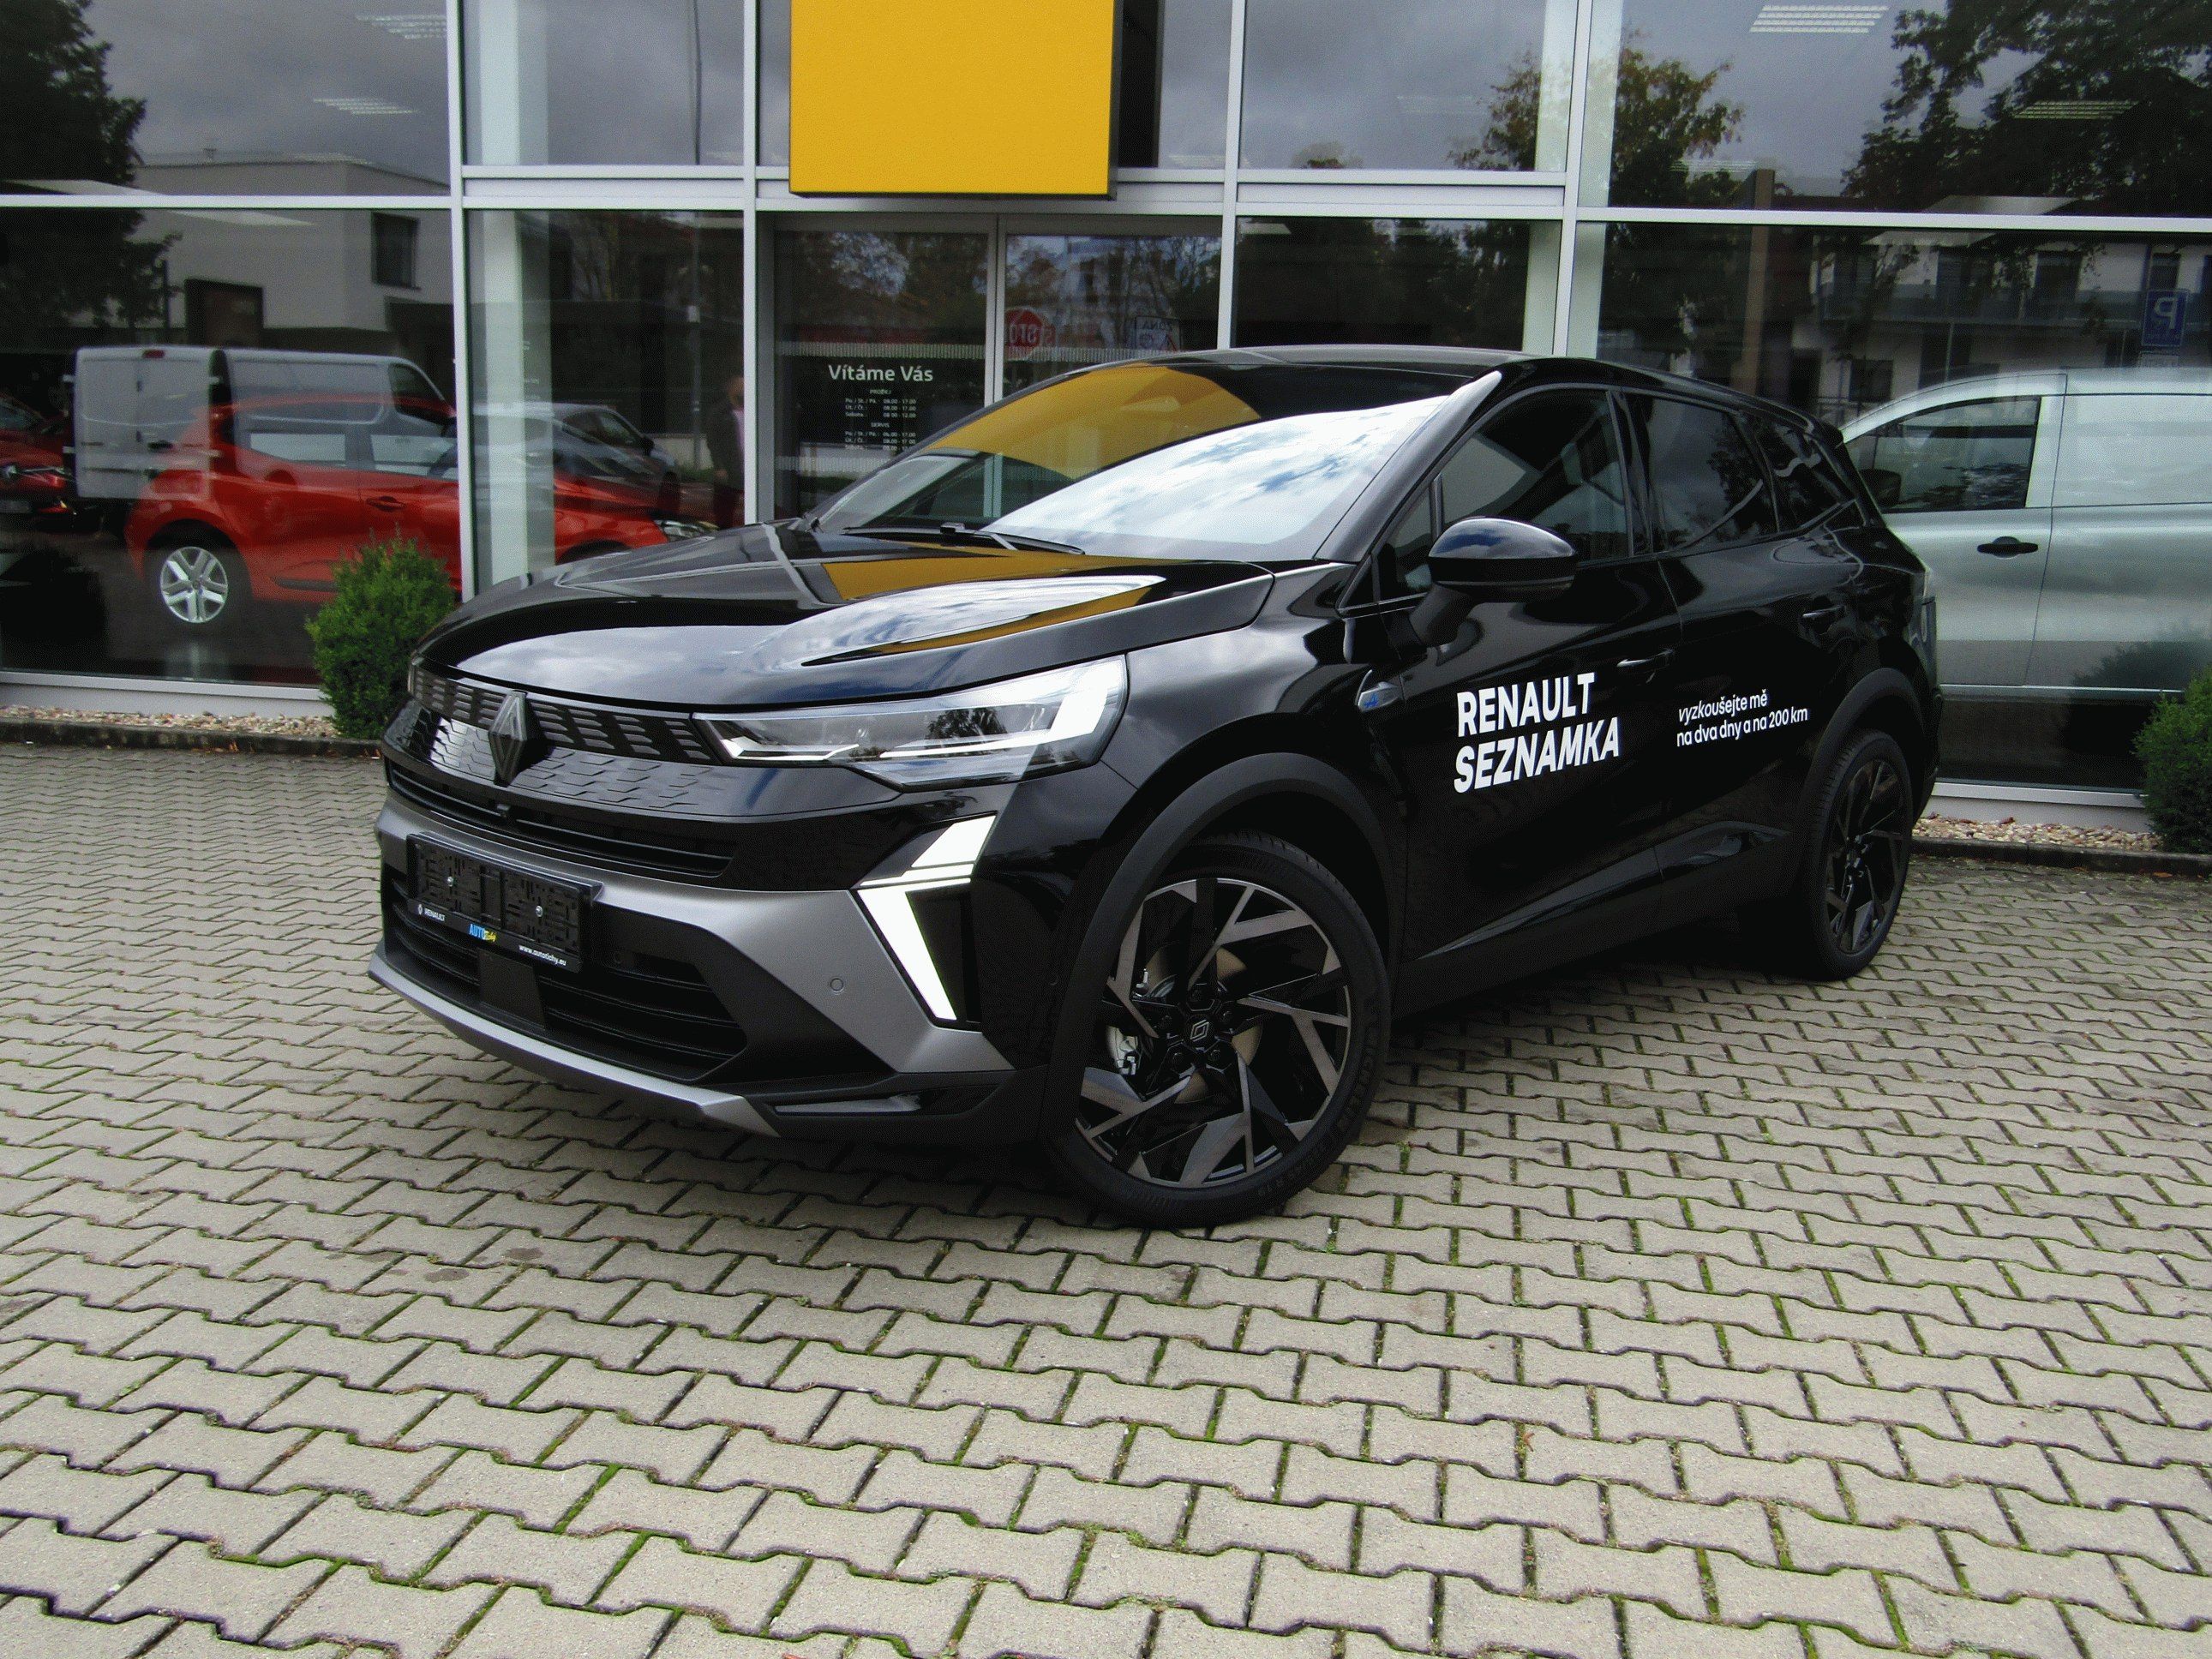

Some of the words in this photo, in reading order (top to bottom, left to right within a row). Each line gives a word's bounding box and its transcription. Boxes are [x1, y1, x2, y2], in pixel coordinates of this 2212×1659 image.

[828, 364, 896, 381] Vítáme
[900, 365, 933, 382] Vás
[1457, 672, 1595, 737] RENAULT
[1678, 693, 1747, 726] vyzkoušejte
[1749, 688, 1768, 710] mě
[1676, 730, 1693, 747] na
[1694, 724, 1717, 744] dva
[1719, 719, 1742, 740] dny
[1743, 722, 1751, 734] a
[1753, 716, 1767, 732] na
[1768, 709, 1789, 728] 200
[1790, 706, 1808, 724] km
[1454, 716, 1619, 793] SEZNAMKA
[423, 907, 446, 922] RENAULT
